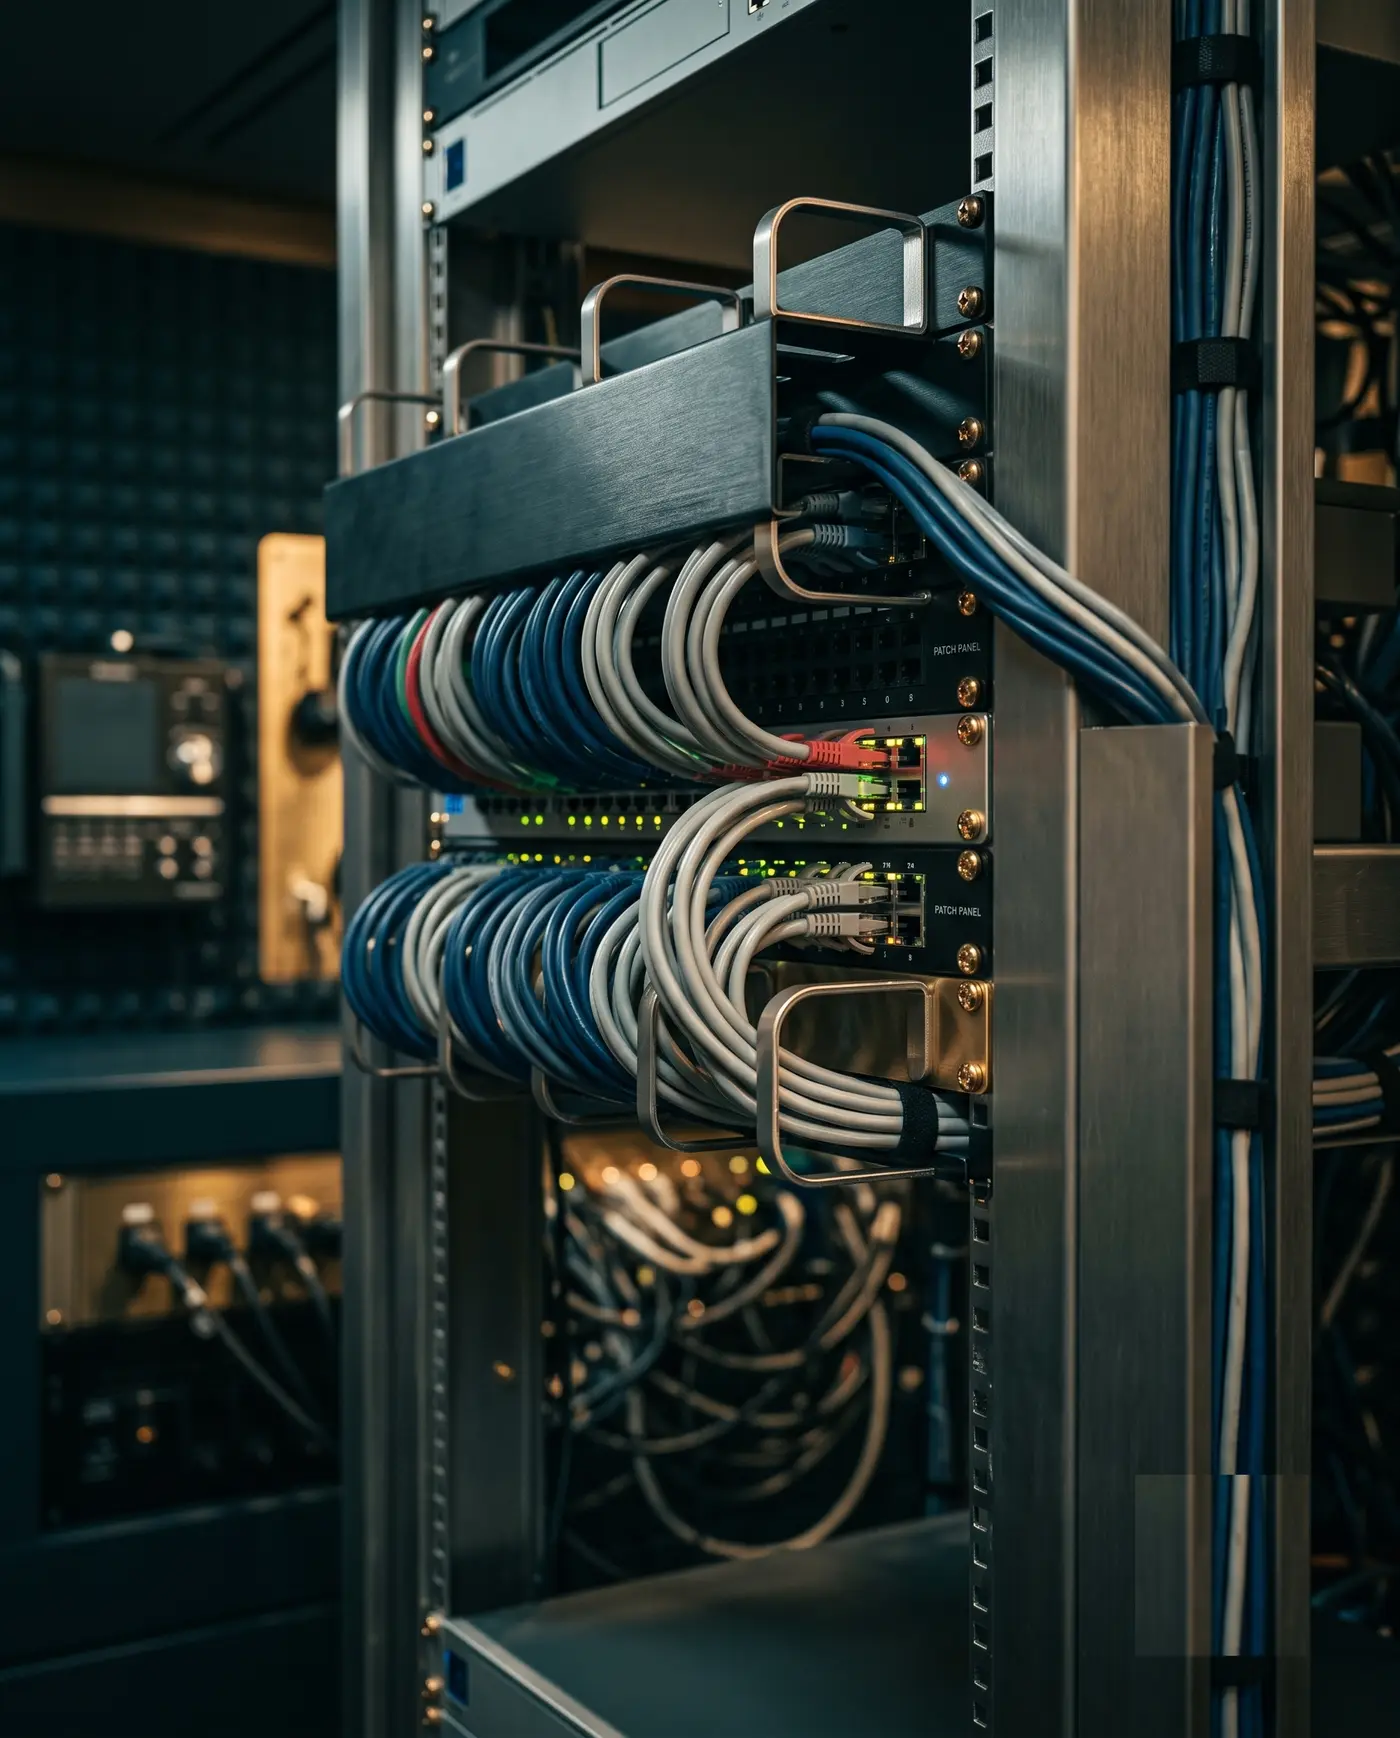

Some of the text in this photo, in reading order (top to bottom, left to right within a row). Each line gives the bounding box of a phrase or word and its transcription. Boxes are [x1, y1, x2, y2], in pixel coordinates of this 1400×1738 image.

[933, 642, 981, 656] PATCH PANEL
[934, 904, 981, 917] PATCH PANEL
